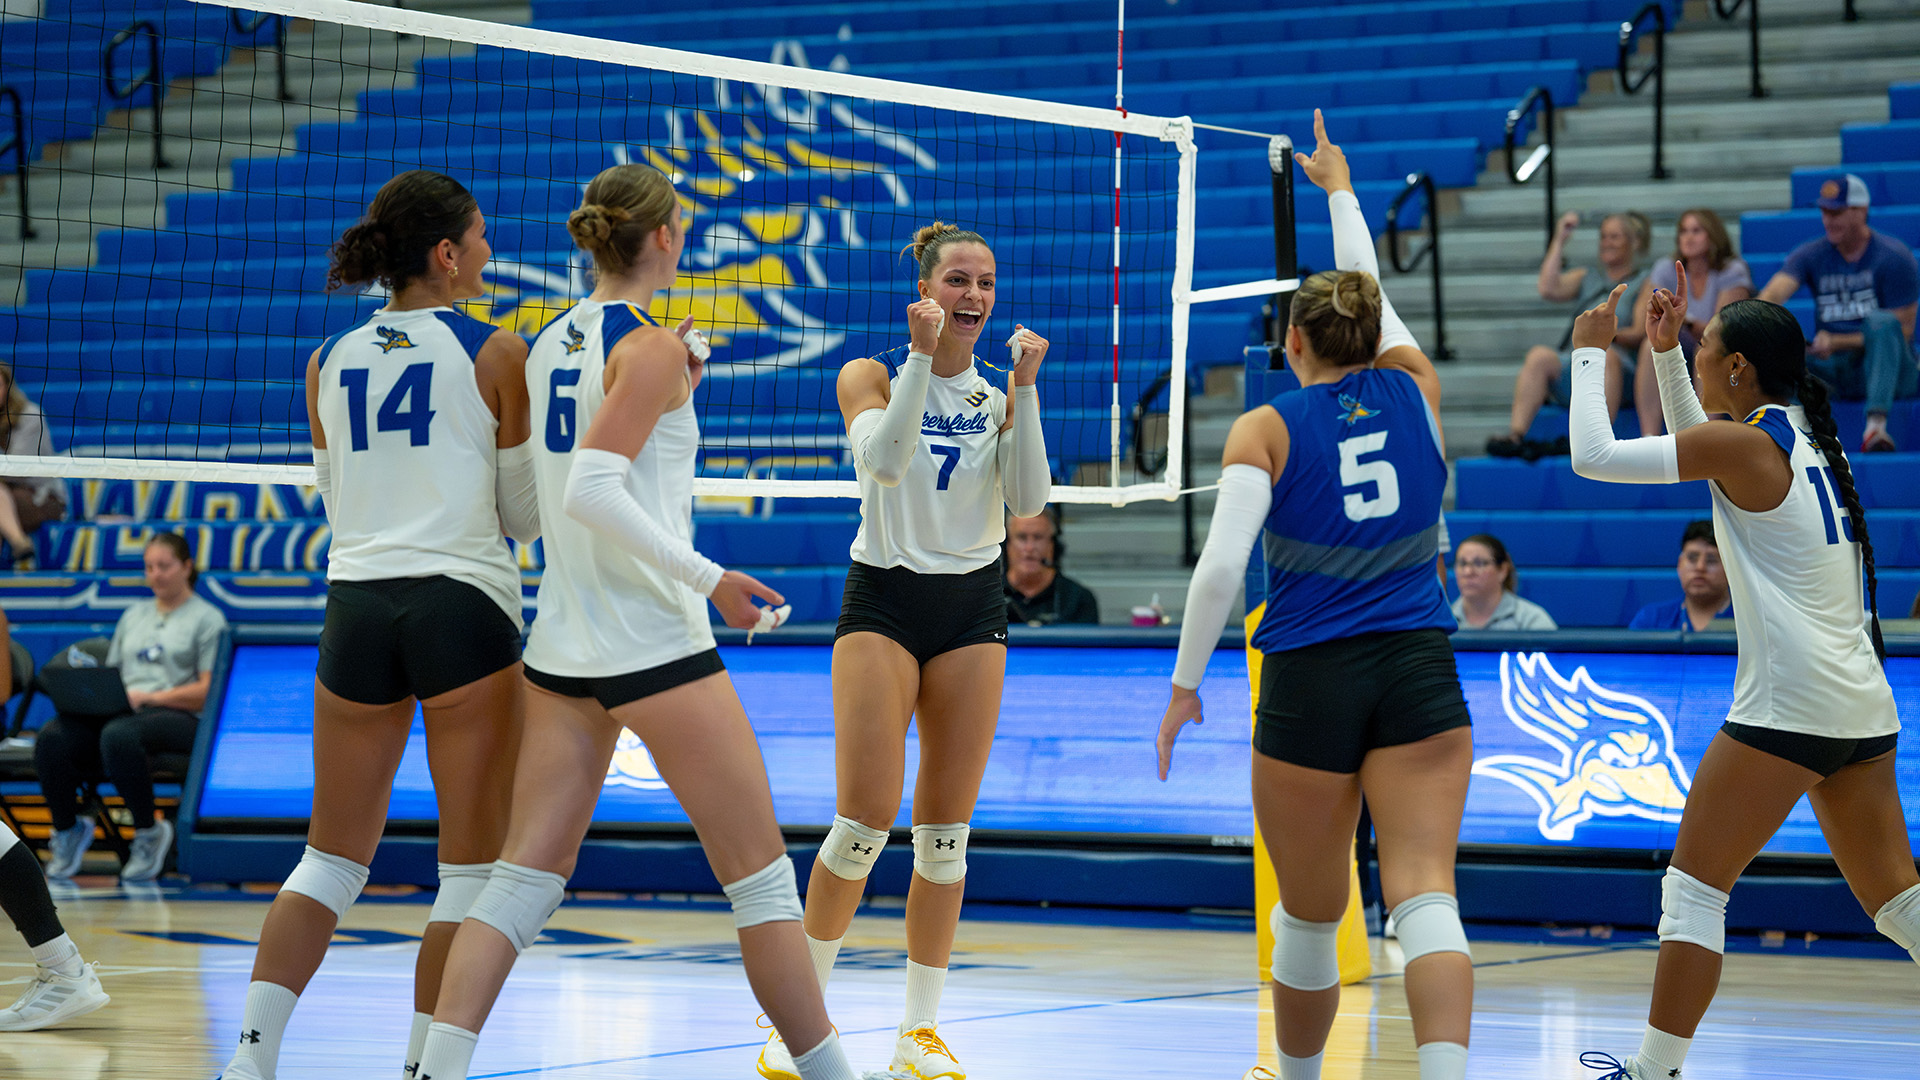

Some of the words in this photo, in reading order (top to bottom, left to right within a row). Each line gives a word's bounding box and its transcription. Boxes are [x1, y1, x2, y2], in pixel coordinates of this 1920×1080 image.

[340, 362, 436, 452] 14
[545, 368, 581, 453] 6
[921, 411, 989, 438] kersfield
[930, 444, 961, 491] 7
[1337, 430, 1400, 523] 5
